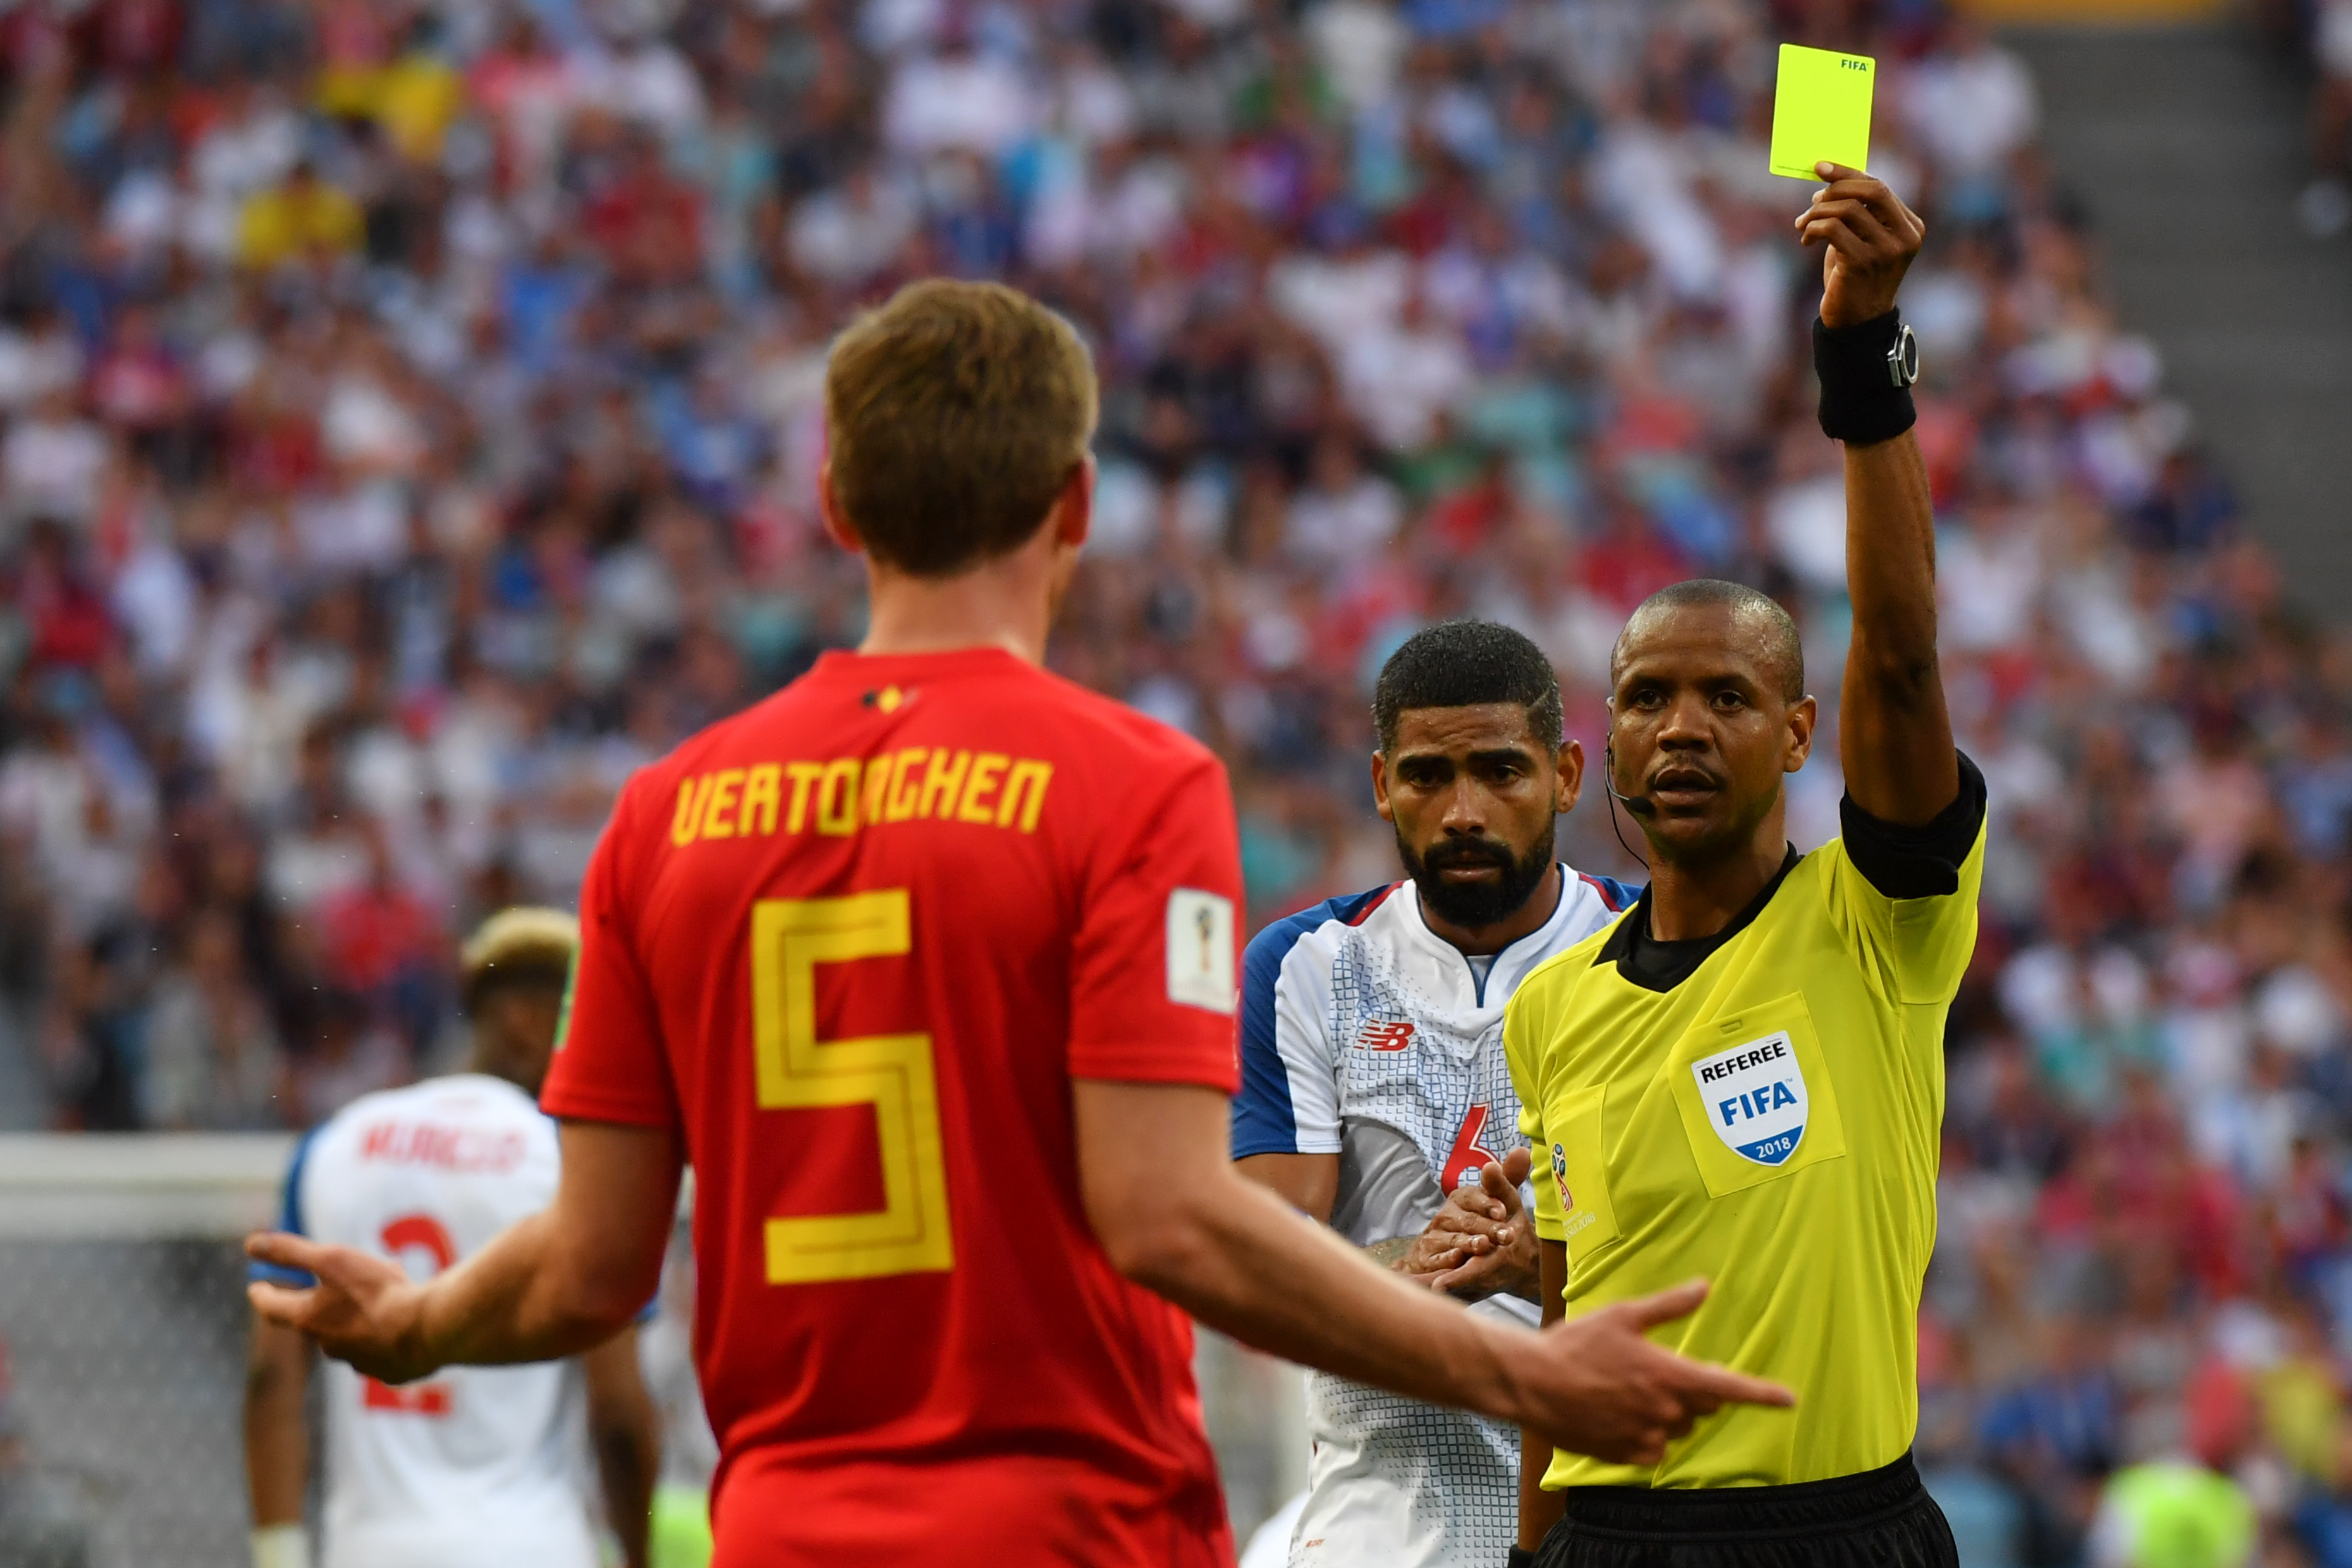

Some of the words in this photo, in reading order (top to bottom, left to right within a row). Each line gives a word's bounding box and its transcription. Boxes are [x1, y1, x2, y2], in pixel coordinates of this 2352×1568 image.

[1841, 59, 1867, 72] FIFA
[1701, 1041, 1787, 1084] REFEREE
[750, 887, 955, 1286] 5
[1718, 1081, 1798, 1127] FIFA
[1440, 1101, 1502, 1199] 6
[1756, 1137, 1791, 1158] 2018
